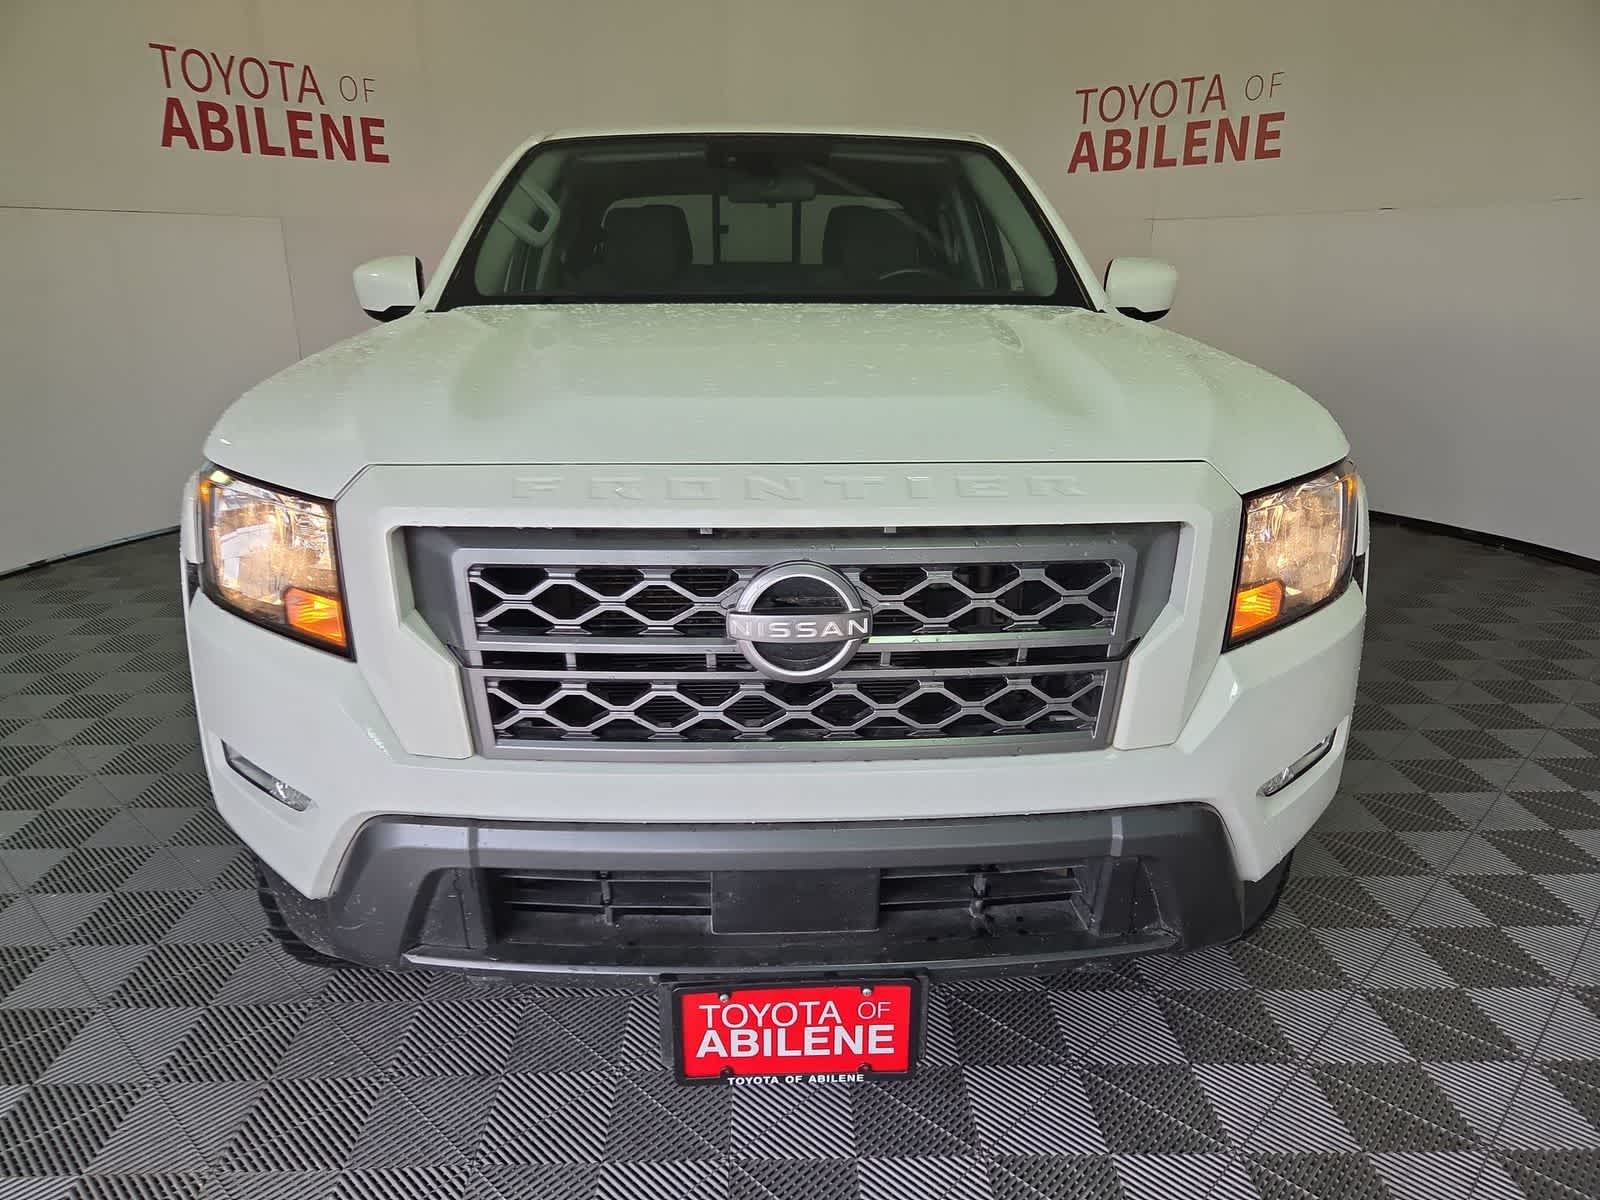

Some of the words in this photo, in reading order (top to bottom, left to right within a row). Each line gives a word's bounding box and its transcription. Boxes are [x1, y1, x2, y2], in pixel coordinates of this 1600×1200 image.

[148, 42, 325, 106] TOYOTA
[339, 75, 376, 103] OF
[1075, 73, 1227, 125] TOYOTA
[1244, 71, 1285, 101] OF
[160, 96, 390, 164] ABILENE
[1067, 111, 1286, 174] ABILENE
[511, 474, 1088, 501] FRONTIER
[730, 617, 869, 640] NISSAN
[699, 1000, 842, 1029] TOYOTA
[857, 1001, 892, 1020] OF
[696, 1024, 895, 1058] ABILENE
[727, 1075, 780, 1086] TOYOTA
[784, 1074, 803, 1084] OF
[808, 1073, 865, 1084] ABILENE
